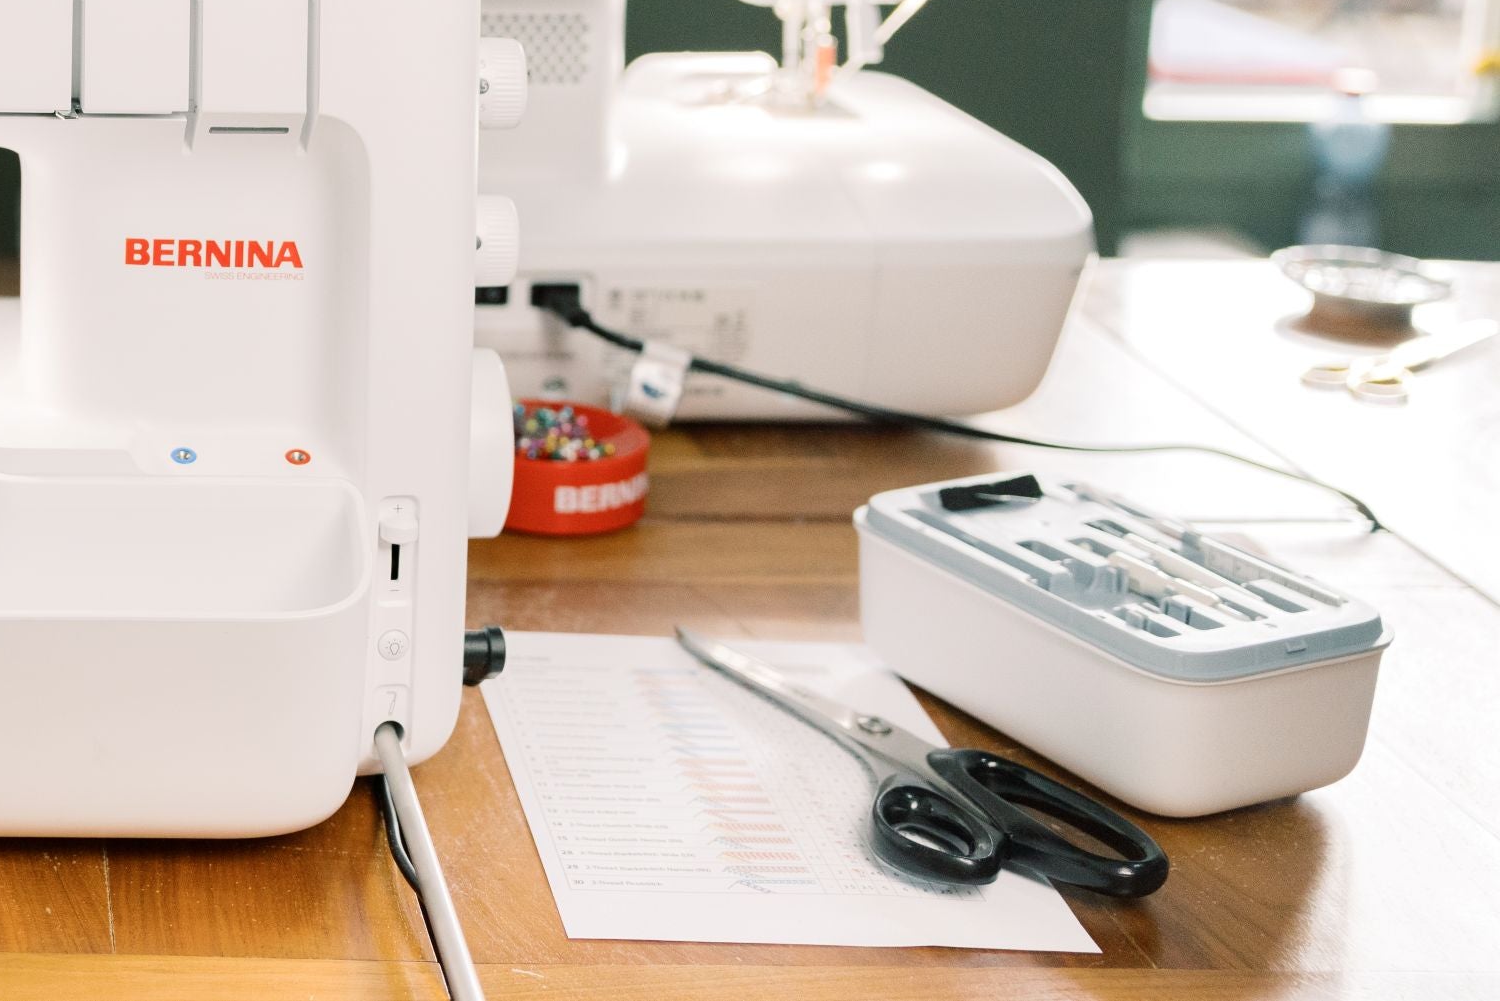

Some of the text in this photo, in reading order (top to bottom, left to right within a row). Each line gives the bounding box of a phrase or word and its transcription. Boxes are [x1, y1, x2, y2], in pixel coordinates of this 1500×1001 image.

[124, 238, 304, 268] BERNINA
[204, 272, 304, 281] SWISS ENGINEERING
